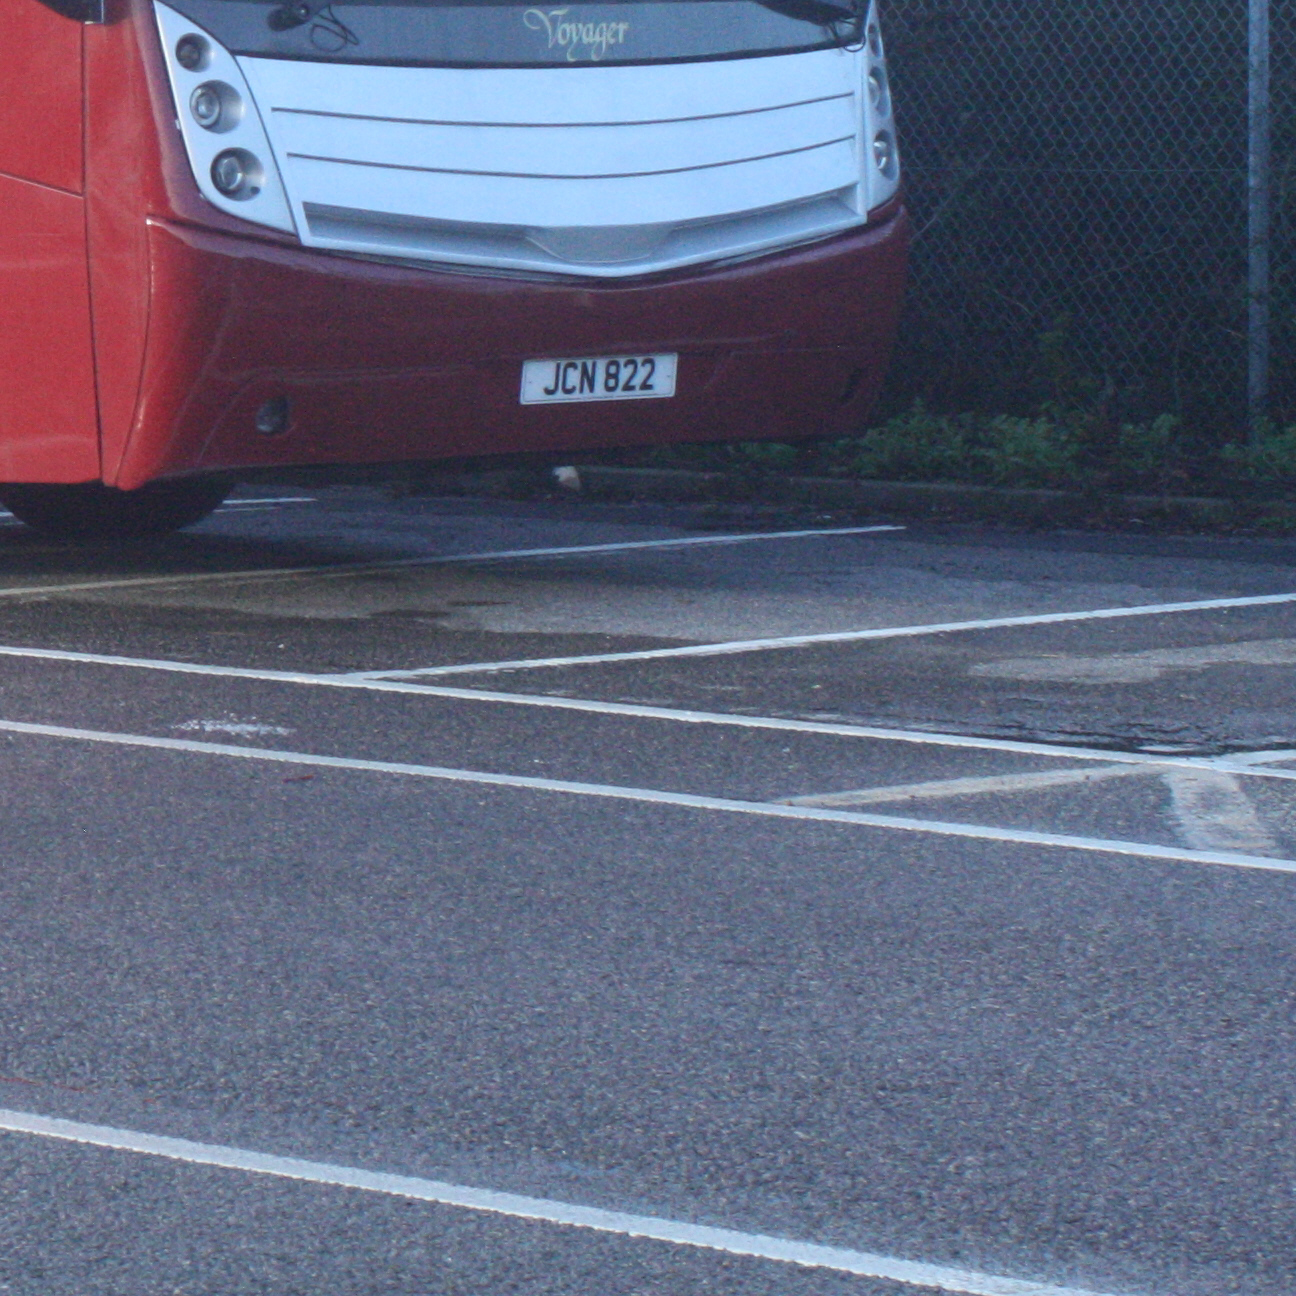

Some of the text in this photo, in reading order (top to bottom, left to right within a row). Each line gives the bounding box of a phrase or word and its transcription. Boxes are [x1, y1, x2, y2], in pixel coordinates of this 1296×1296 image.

[523, 7, 630, 62] Voyager
[542, 357, 656, 396] JCN 822
